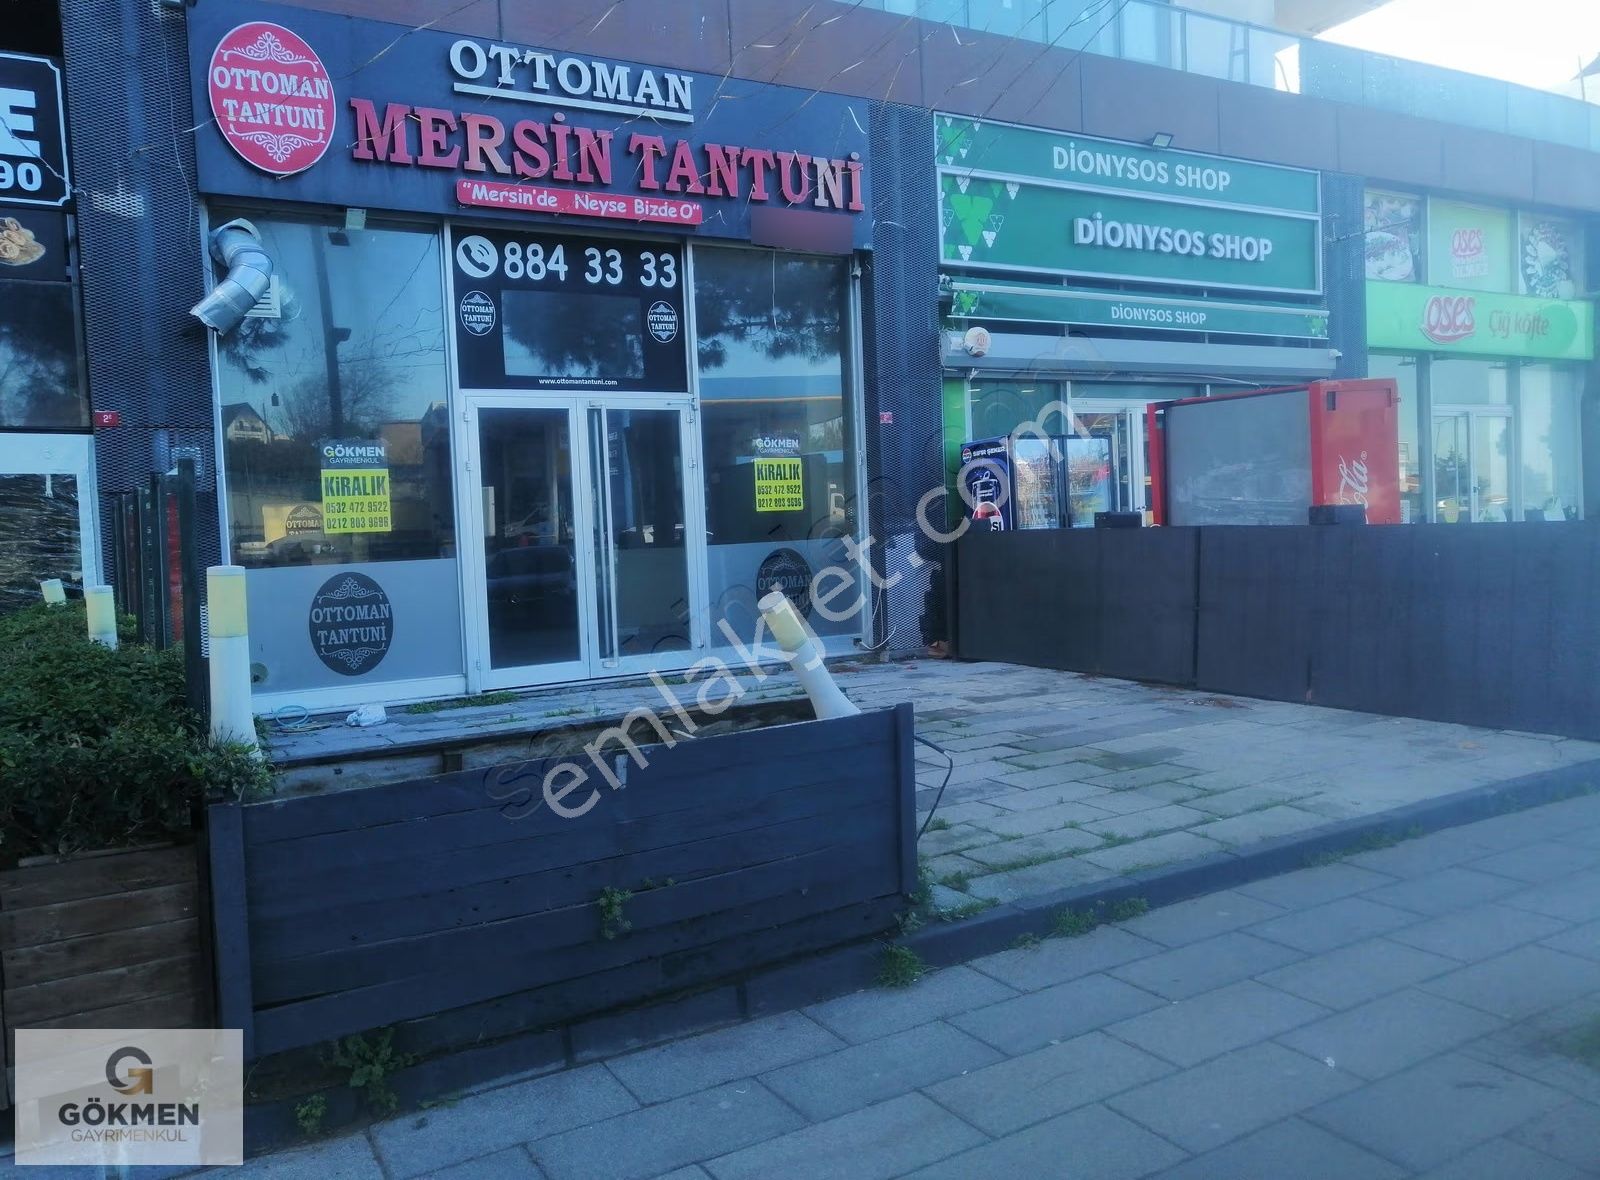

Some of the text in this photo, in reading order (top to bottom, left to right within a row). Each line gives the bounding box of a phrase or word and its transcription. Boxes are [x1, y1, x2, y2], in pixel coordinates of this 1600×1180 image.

[213, 66, 329, 99] OTTOMAN
[450, 40, 693, 110] OTTOMAN
[222, 98, 326, 131] TANTUNİ
[350, 97, 865, 212] MERSİN TANTUNİ
[1053, 142, 1231, 192] DİONYSOS SHOP
[574, 193, 627, 215] Neyse
[634, 198, 677, 218] Bizde
[1073, 212, 1272, 262] DİONYSOS SHOP
[504, 242, 676, 288] 884 33 33
[462, 305, 493, 313] OTTOMAN
[464, 313, 492, 323] TANTUNİ
[649, 314, 676, 322] OTTOMAN
[1111, 303, 1206, 325] DİONYSOS SHOP
[539, 377, 618, 386] www.ottomantantuni.com
[323, 444, 385, 457] GÖKMEN
[756, 437, 799, 448] GÖKMEN
[326, 501, 388, 514] 0532 472 9522
[286, 519, 320, 529] OTTOMA
[326, 517, 347, 529] 0212
[758, 575, 812, 590] OTTOMAN
[311, 603, 390, 624] OTTOMAN
[317, 622, 387, 647] TANTUNİ
